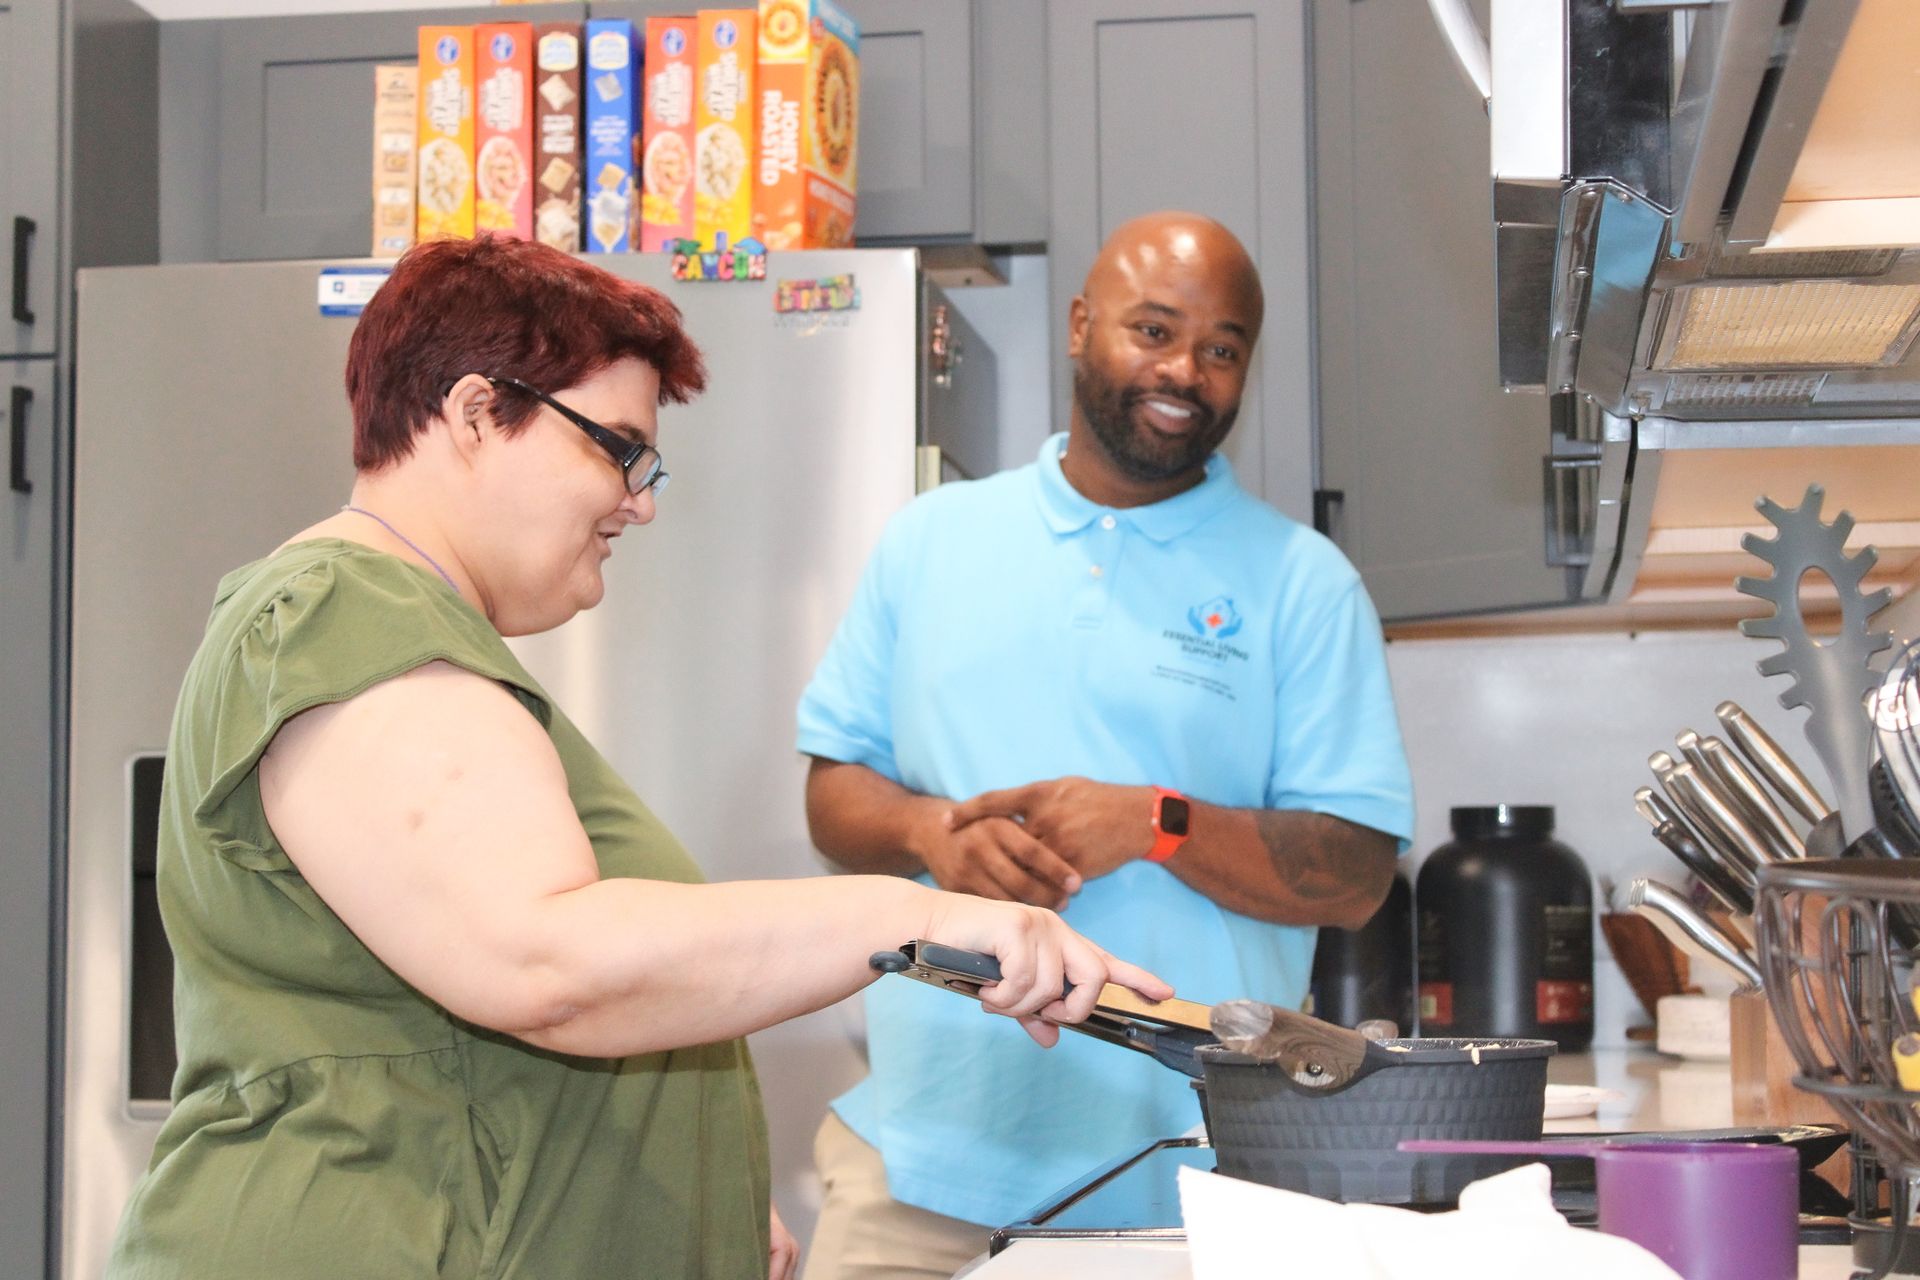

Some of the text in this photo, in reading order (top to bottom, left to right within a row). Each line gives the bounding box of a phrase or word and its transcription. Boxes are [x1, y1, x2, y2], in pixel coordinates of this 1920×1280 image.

[759, 89, 783, 187] ROASTED
[781, 100, 800, 174] HONEY
[1163, 630, 1249, 661] ESSENTIAL LIVING
[1181, 643, 1229, 663] SUPPORT
